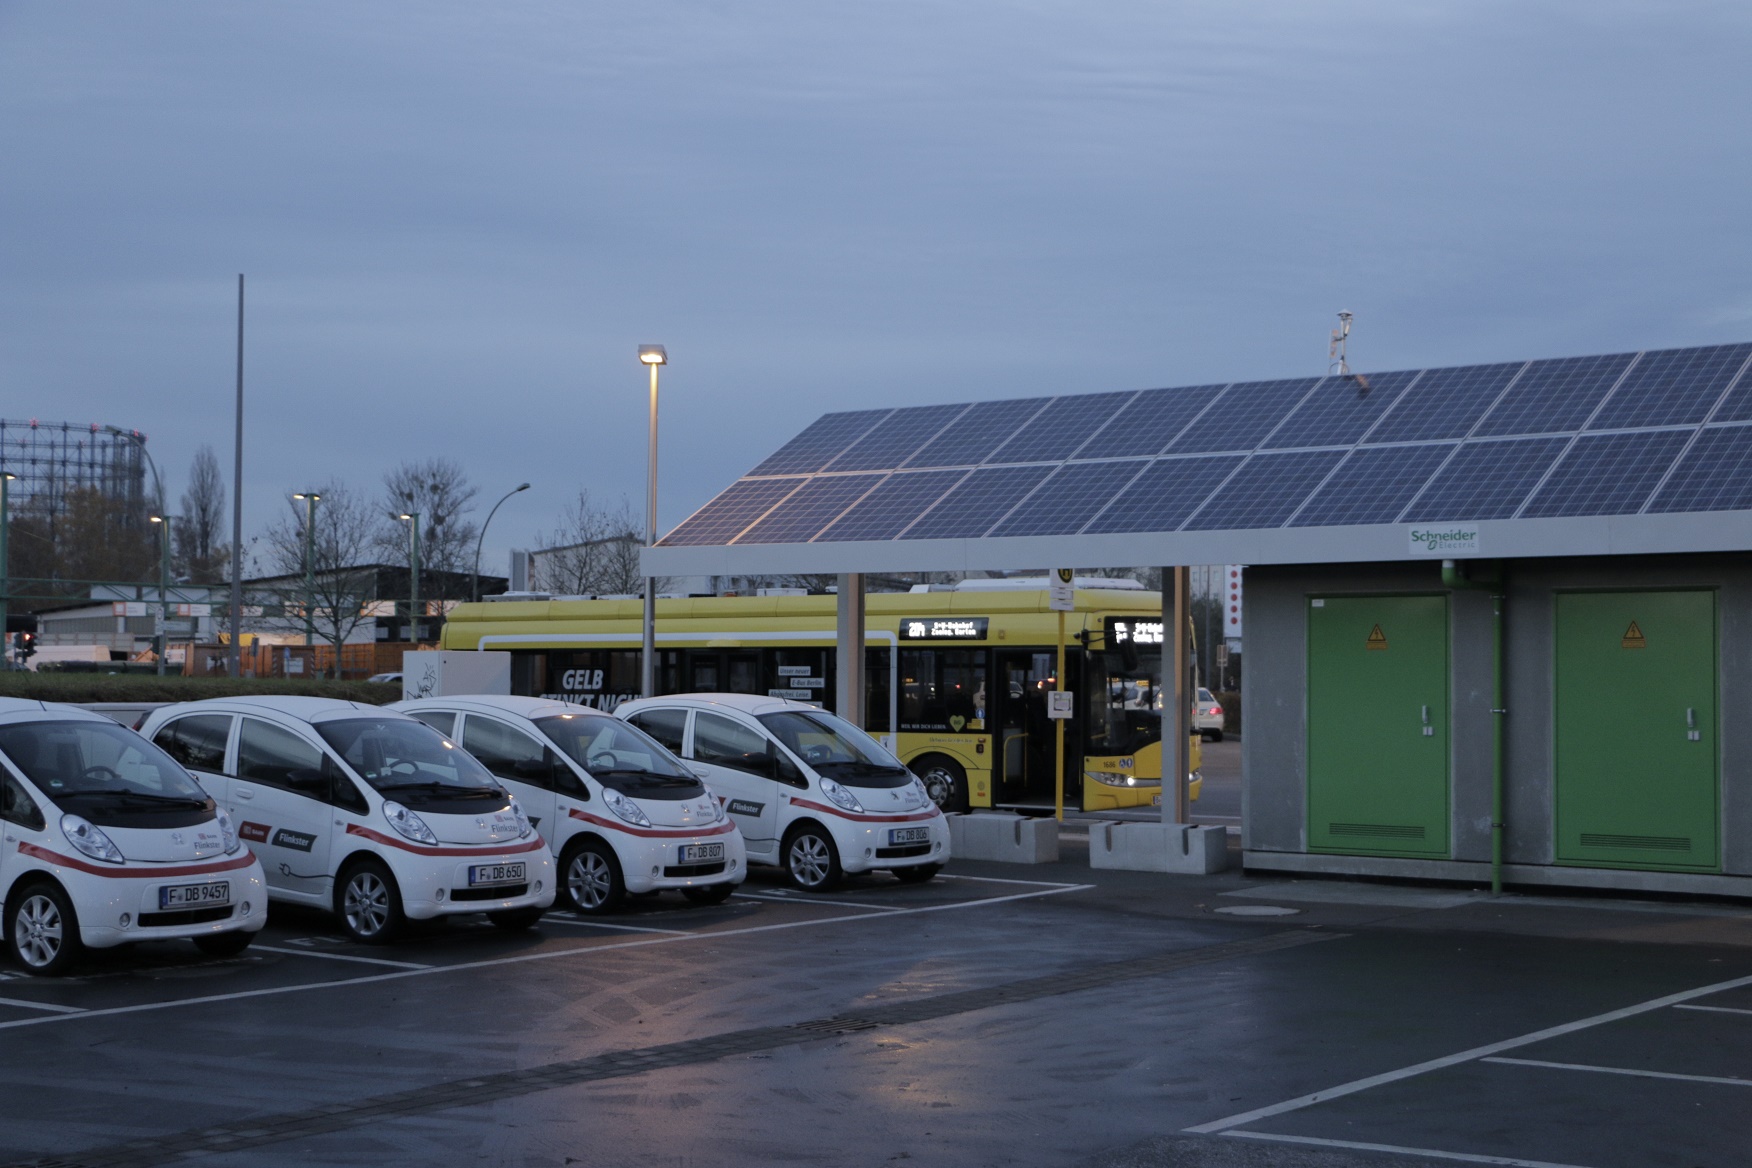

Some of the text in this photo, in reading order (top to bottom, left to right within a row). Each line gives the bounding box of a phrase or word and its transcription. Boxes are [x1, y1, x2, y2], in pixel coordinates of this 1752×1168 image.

[1411, 529, 1476, 542] Schneider
[1439, 541, 1475, 549] Electric
[562, 669, 604, 690] GELB
[732, 802, 759, 813] Flinkster
[491, 824, 518, 833] Flinkster
[896, 829, 927, 841] F DB 806
[279, 832, 309, 847] Flinkster
[687, 845, 721, 858] F DB 807
[480, 865, 522, 880] F DB 650
[169, 884, 227, 902] F DB 9457
